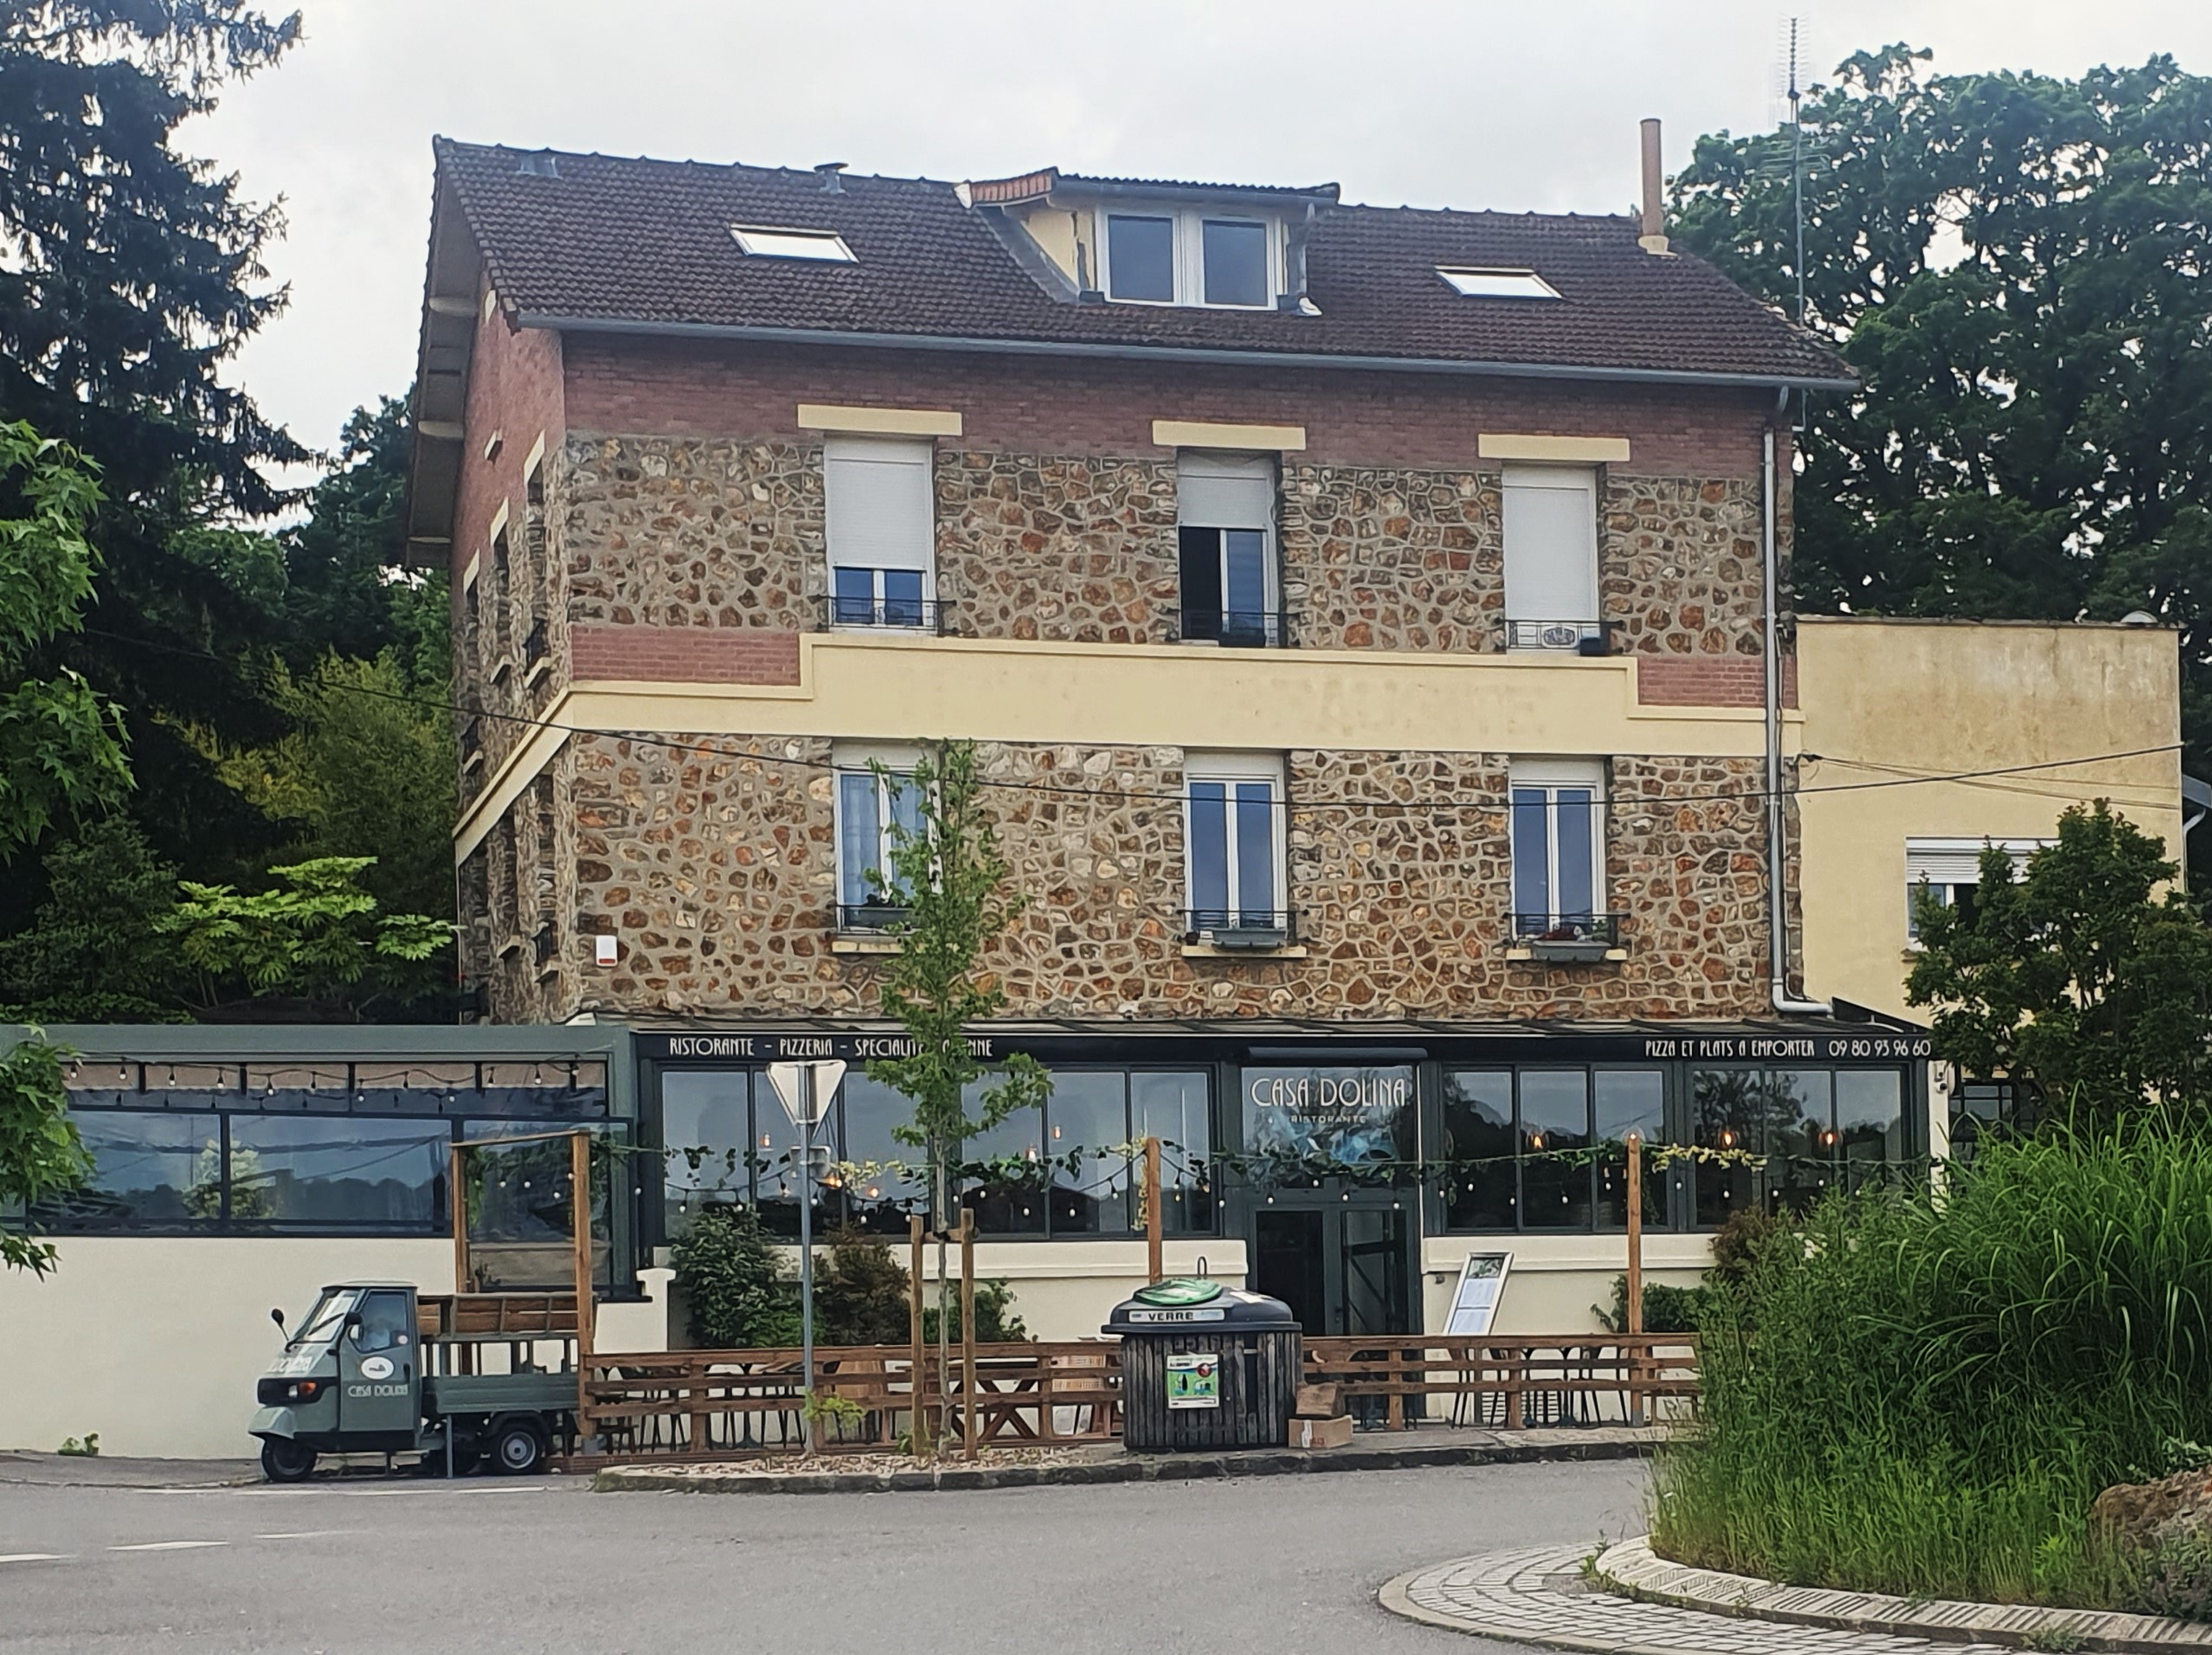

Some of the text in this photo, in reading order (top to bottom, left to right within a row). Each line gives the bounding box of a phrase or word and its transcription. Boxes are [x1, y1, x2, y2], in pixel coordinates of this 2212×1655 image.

[670, 1038, 755, 1056] RISTORANTE
[780, 1038, 833, 1056] PIZZERIA
[1645, 1040, 1675, 1057] PIZZA
[1682, 1040, 1694, 1057] ET
[1700, 1040, 1733, 1057] PLATS
[1751, 1040, 1815, 1057] EMPORTER
[1829, 1040, 1848, 1057] 09
[1851, 1040, 1871, 1057] 80
[1874, 1040, 1889, 1057] 93
[1893, 1040, 1909, 1057] 96
[1912, 1040, 1932, 1057] 60
[1251, 1078, 1406, 1107] CASA DOLINA
[1290, 1114, 1367, 1124] RISTORANTE
[1148, 1311, 1194, 1321] VERRE
